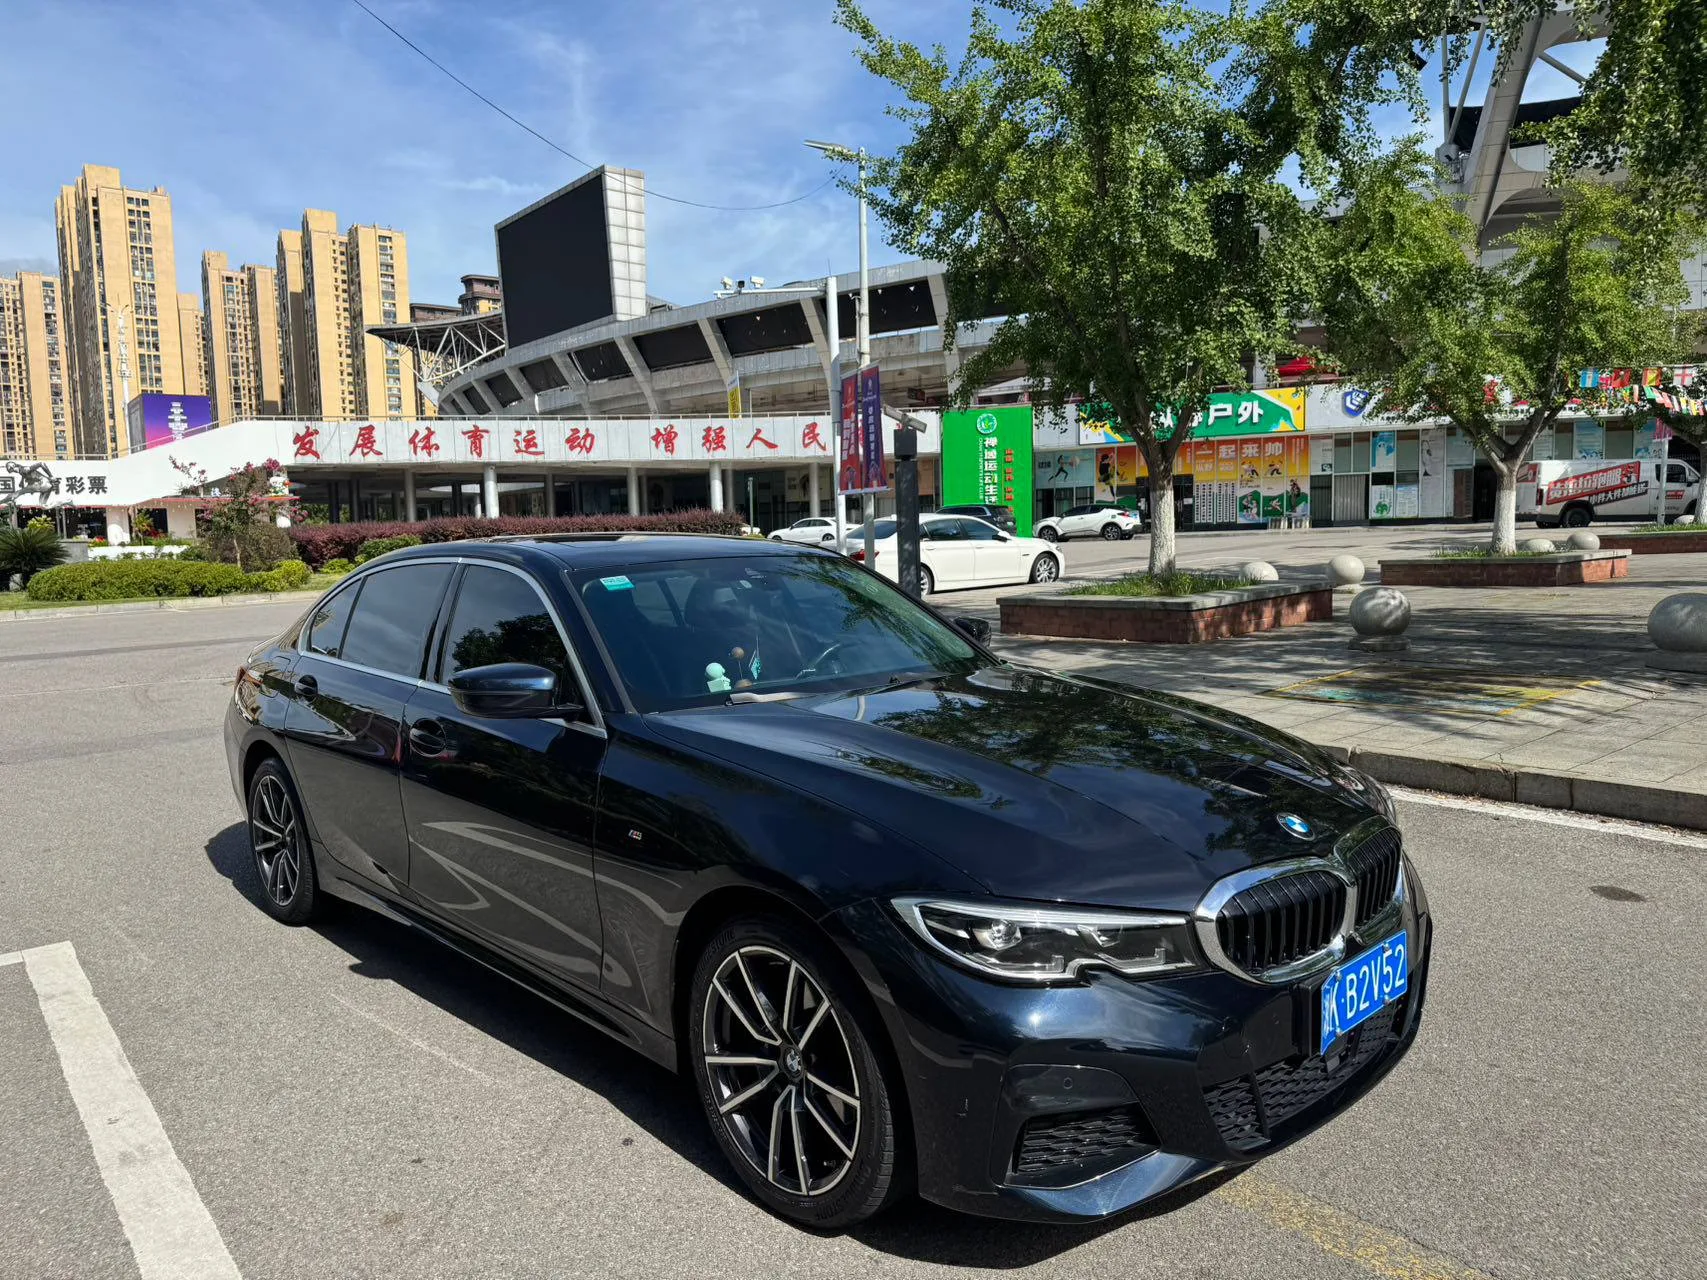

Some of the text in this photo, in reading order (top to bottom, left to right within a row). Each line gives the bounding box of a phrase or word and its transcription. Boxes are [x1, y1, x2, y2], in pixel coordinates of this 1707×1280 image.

[293, 424, 596, 458] 发展体育运动
[0, 475, 108, 495] 国育彩票
